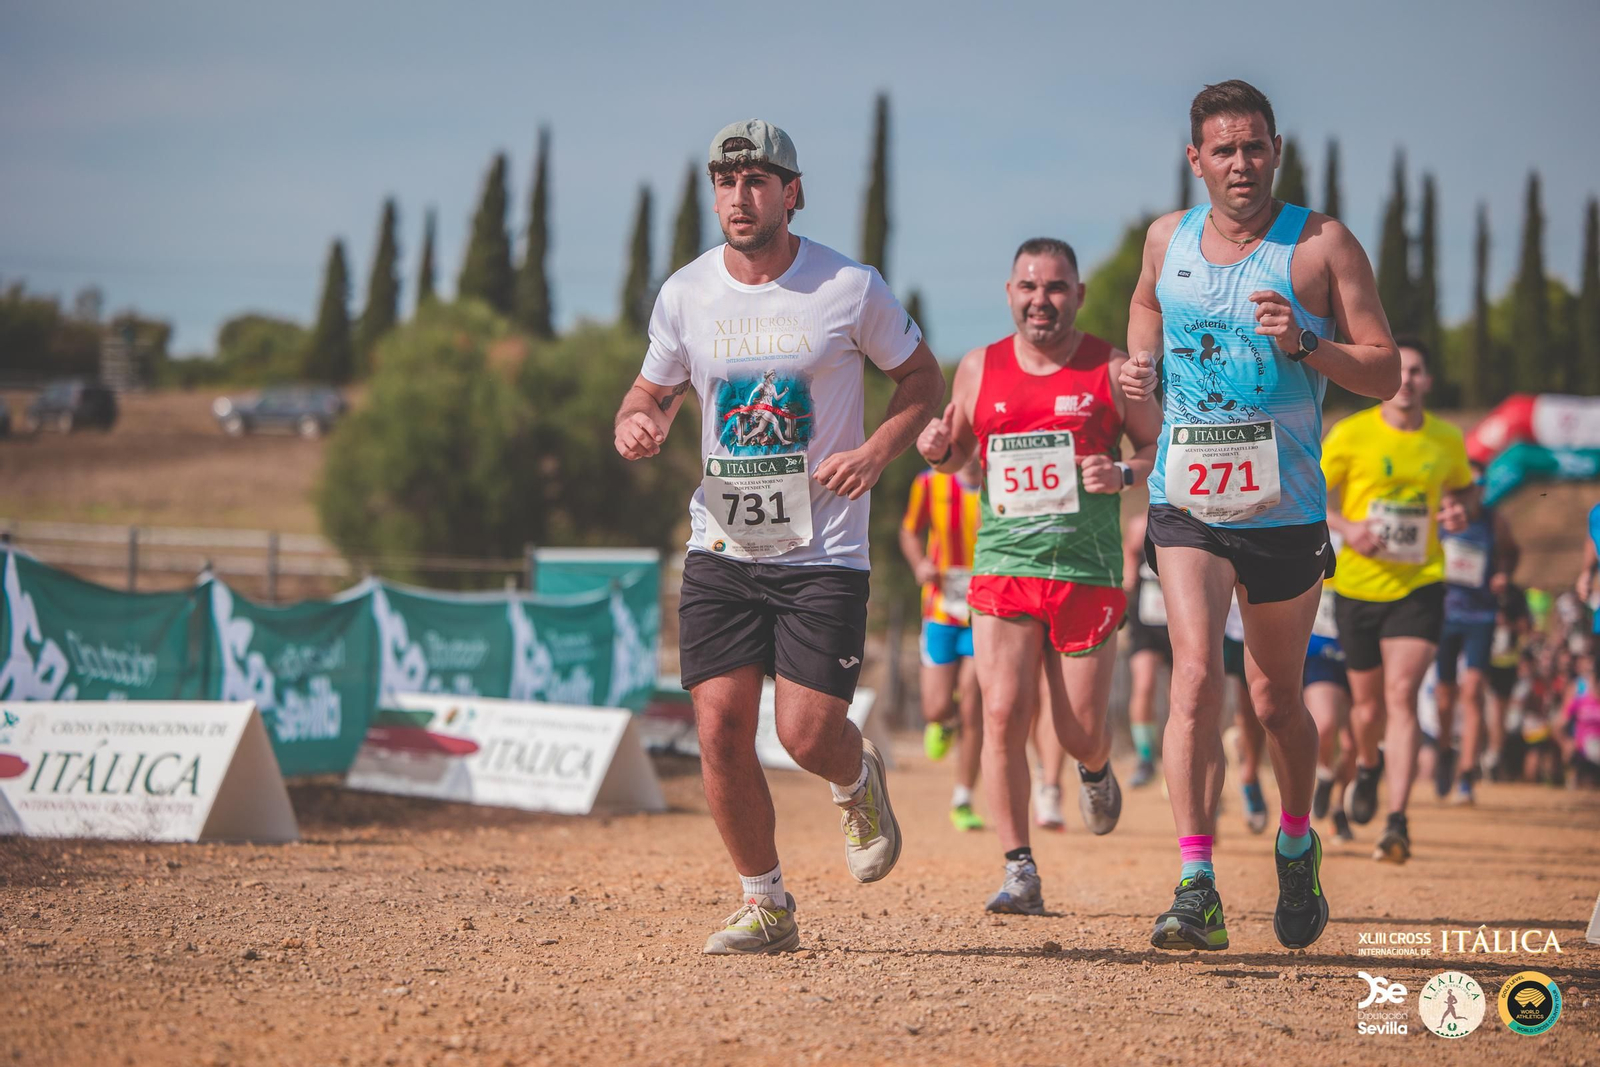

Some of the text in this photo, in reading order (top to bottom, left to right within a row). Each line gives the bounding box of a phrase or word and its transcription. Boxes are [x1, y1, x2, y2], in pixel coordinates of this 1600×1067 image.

[715, 316, 799, 336] XLIII CROSS
[713, 332, 813, 359] ITÁLICA
[1184, 319, 1227, 334] Cafetería
[1235, 327, 1267, 376] Cervecería
[1005, 436, 1049, 450] ITÁLICA
[1194, 428, 1246, 441] ITÁLICA
[727, 461, 777, 474] ITÁLICA
[1003, 463, 1060, 493] 516
[1188, 460, 1260, 495] 271
[722, 491, 791, 526] 731
[51, 720, 229, 737] CROSS INTERNACIONAL DE
[28, 738, 202, 797] ITÁLICA
